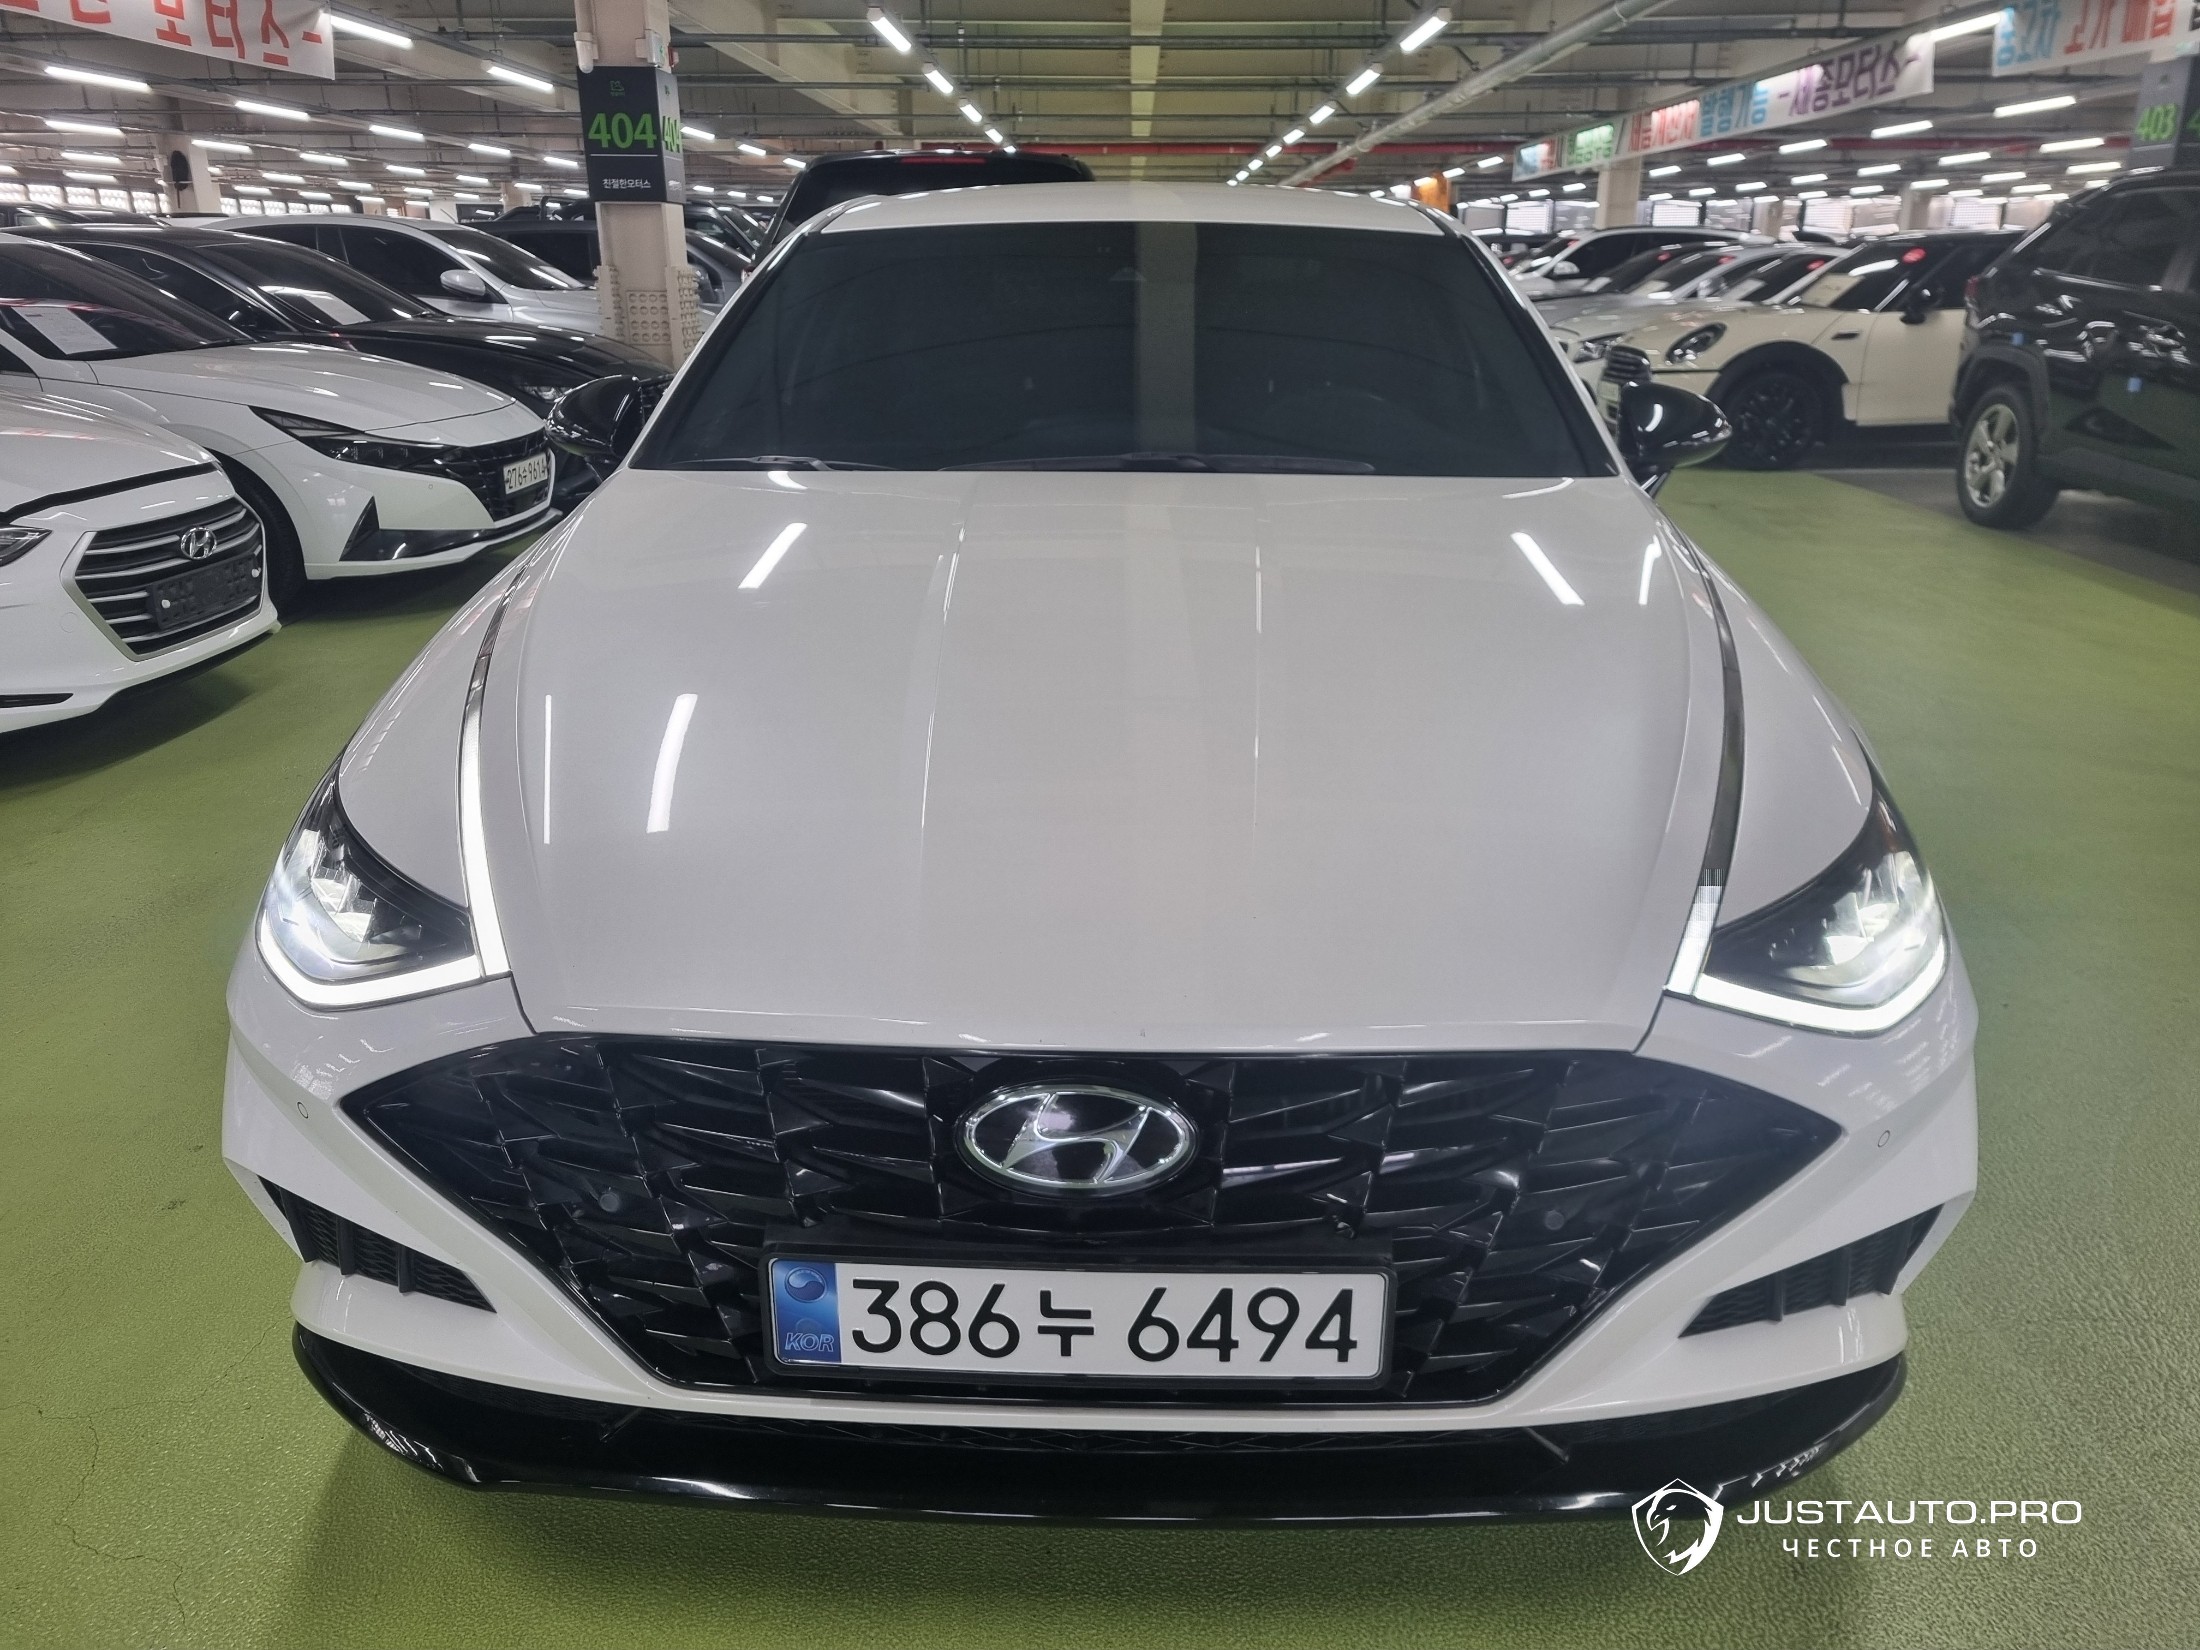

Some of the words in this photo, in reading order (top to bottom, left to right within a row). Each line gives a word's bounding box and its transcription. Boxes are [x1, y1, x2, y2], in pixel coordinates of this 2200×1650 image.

[588, 113, 657, 149] 404
[2136, 103, 2177, 141] 403
[785, 1332, 834, 1352] KOR
[1127, 1286, 1357, 1363] 6494
